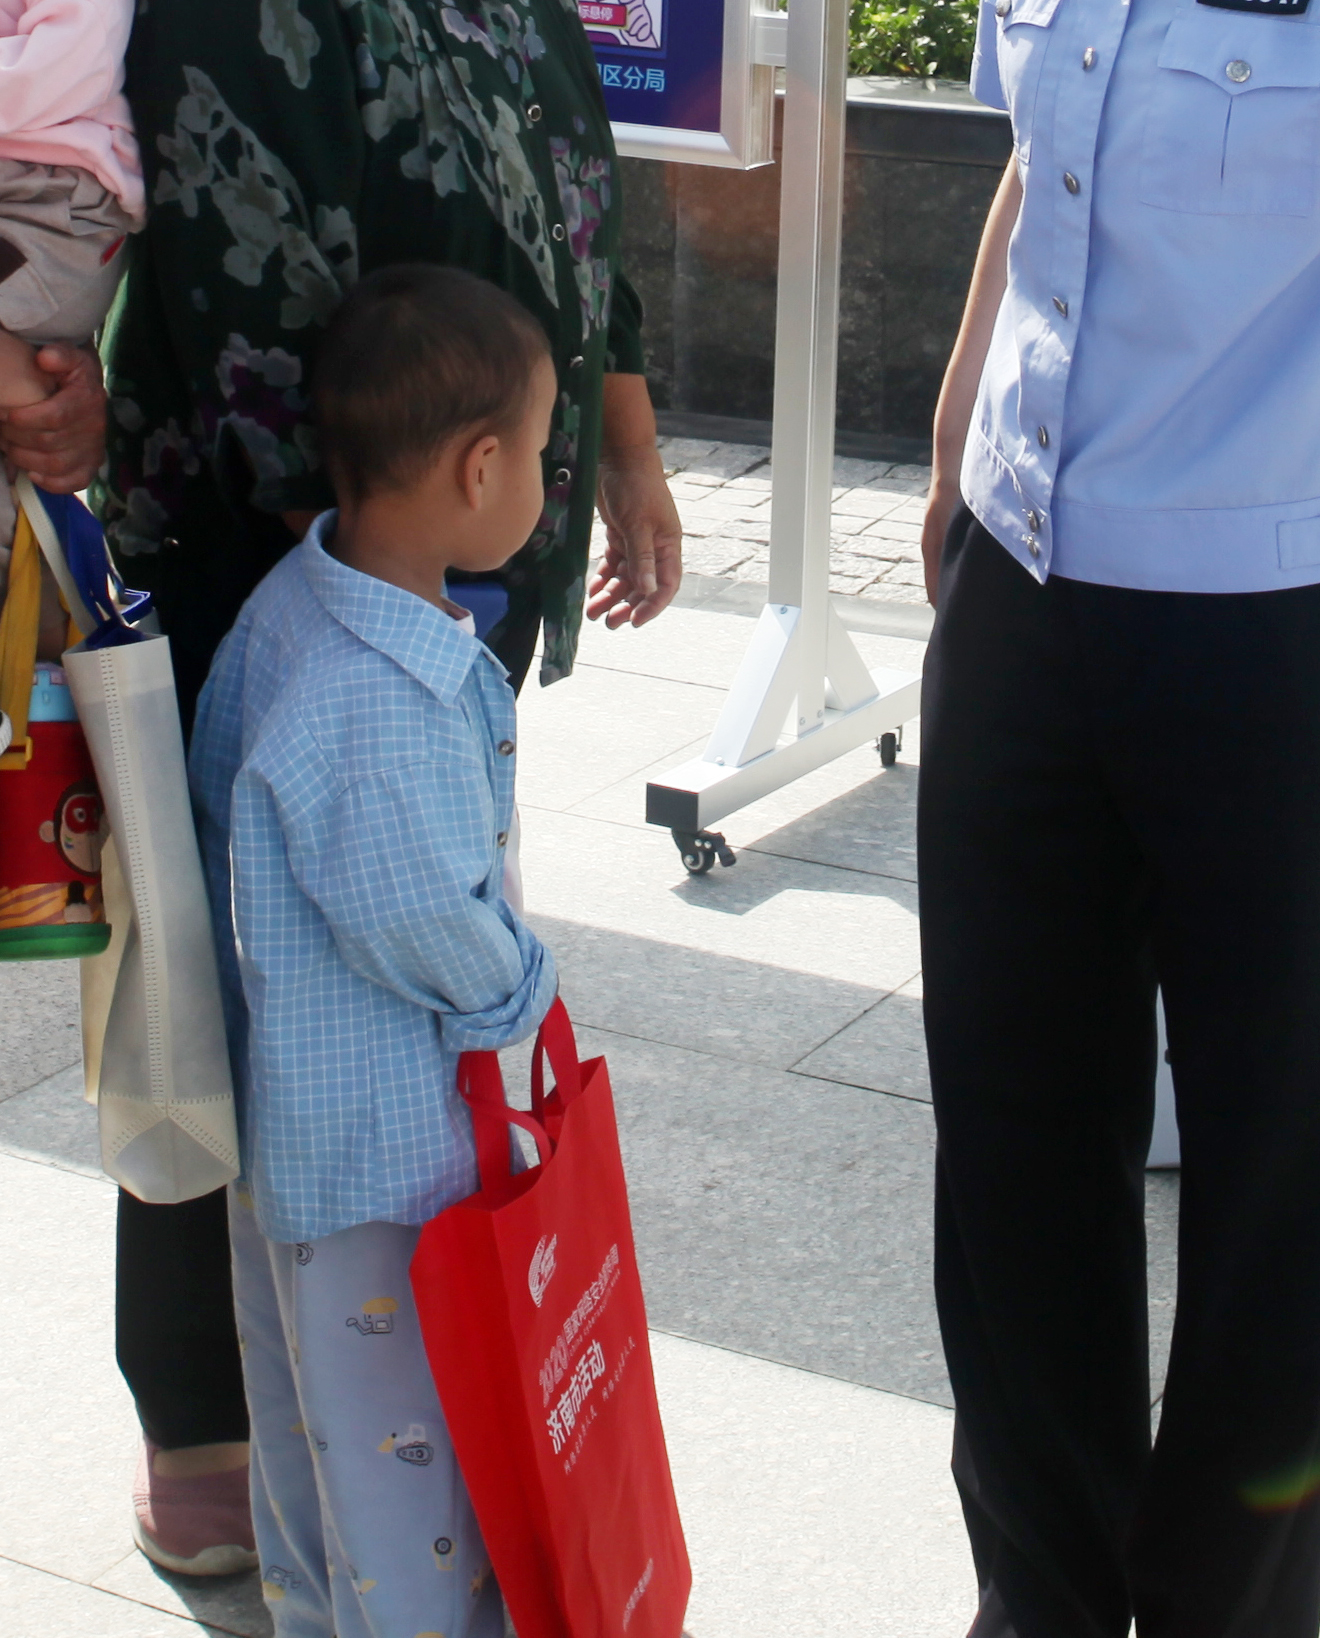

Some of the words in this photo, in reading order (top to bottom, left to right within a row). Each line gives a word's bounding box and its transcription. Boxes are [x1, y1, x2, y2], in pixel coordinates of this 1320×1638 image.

[599, 64, 665, 92] 区分局
[546, 1338, 606, 1455] 济南市活动
